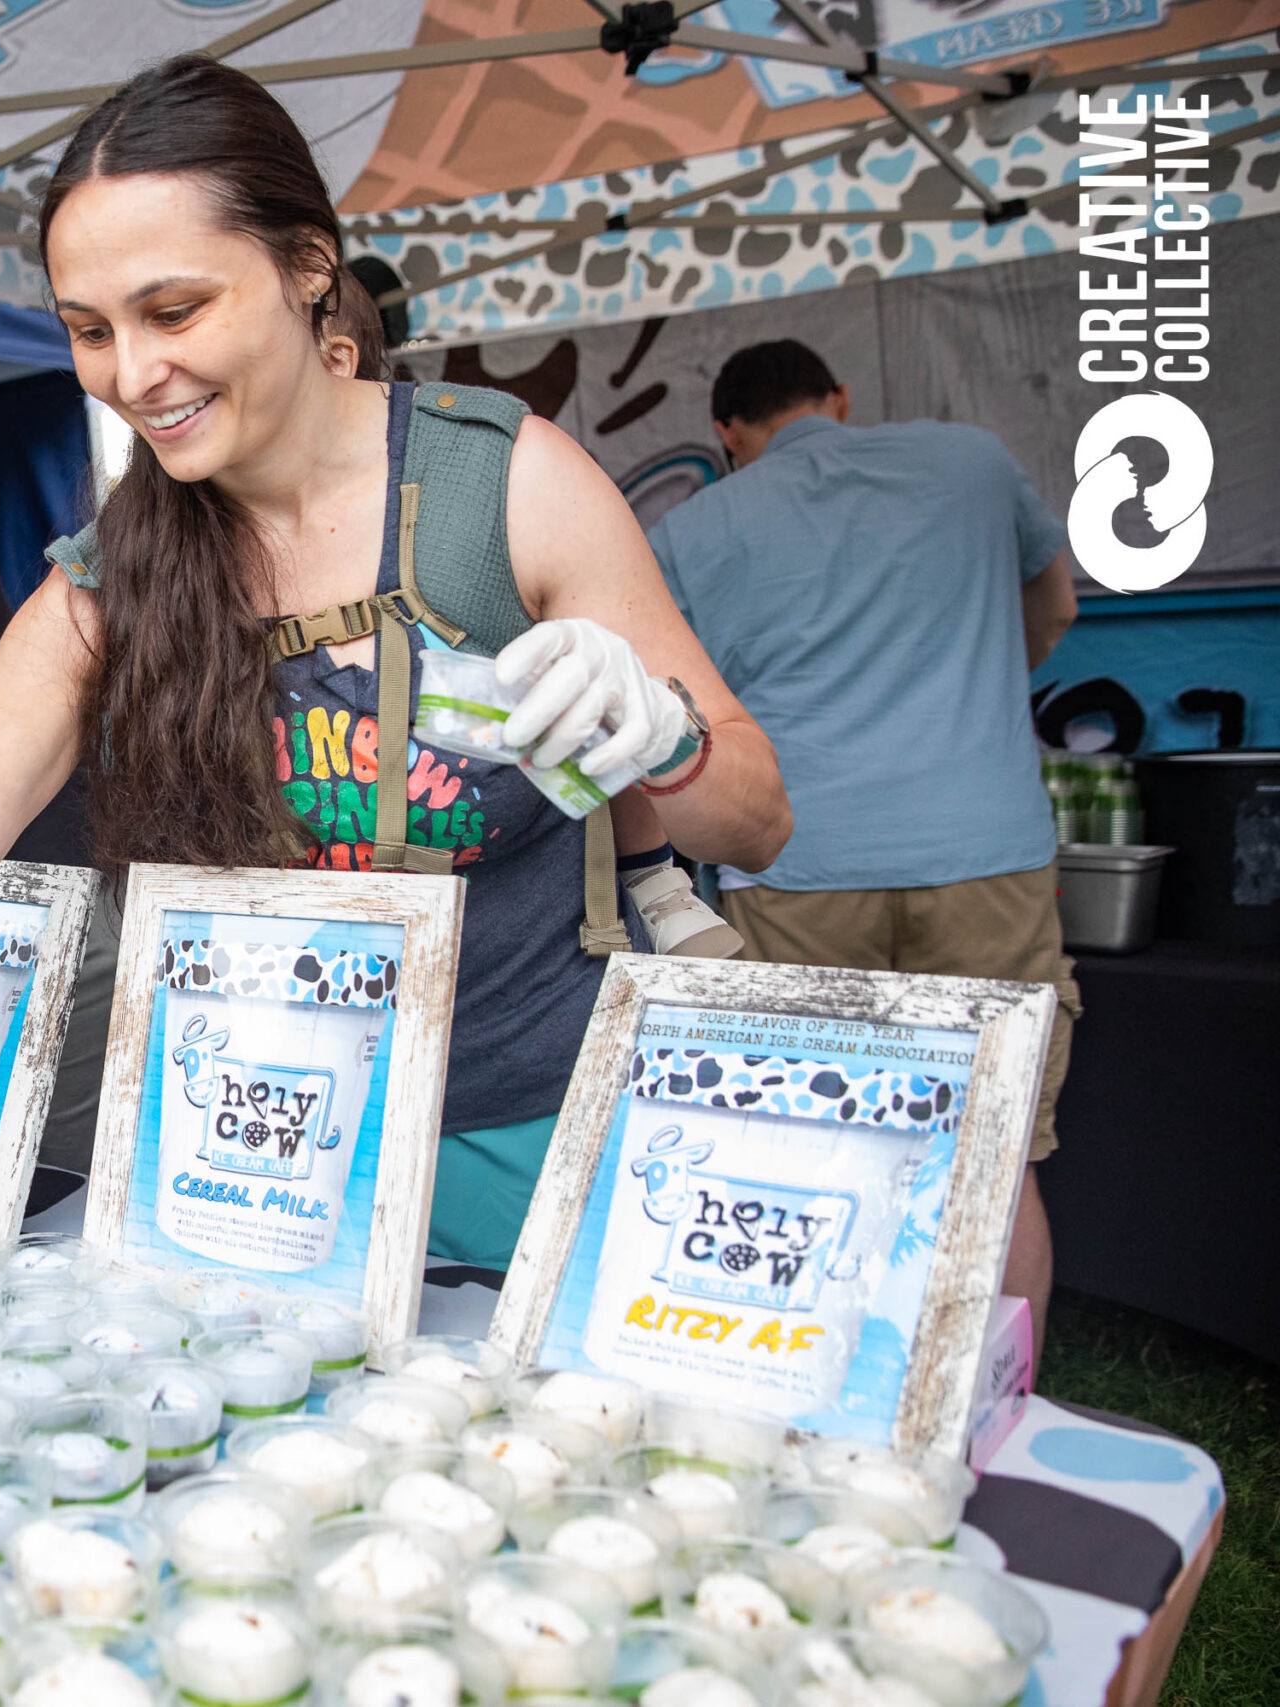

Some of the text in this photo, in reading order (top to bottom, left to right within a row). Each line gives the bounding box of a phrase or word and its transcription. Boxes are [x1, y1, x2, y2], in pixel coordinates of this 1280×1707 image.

[684, 1026, 764, 1046] AMERICAN
[767, 1033, 797, 1048] ICE
[801, 1037, 858, 1054] CREAM
[697, 1011, 916, 1042] 2022 FLAVOR OF THE YEAR
[221, 1074, 318, 1126] holy
[173, 1171, 329, 1221] CEREAL MILK
[624, 1293, 825, 1355] RITZY AF
